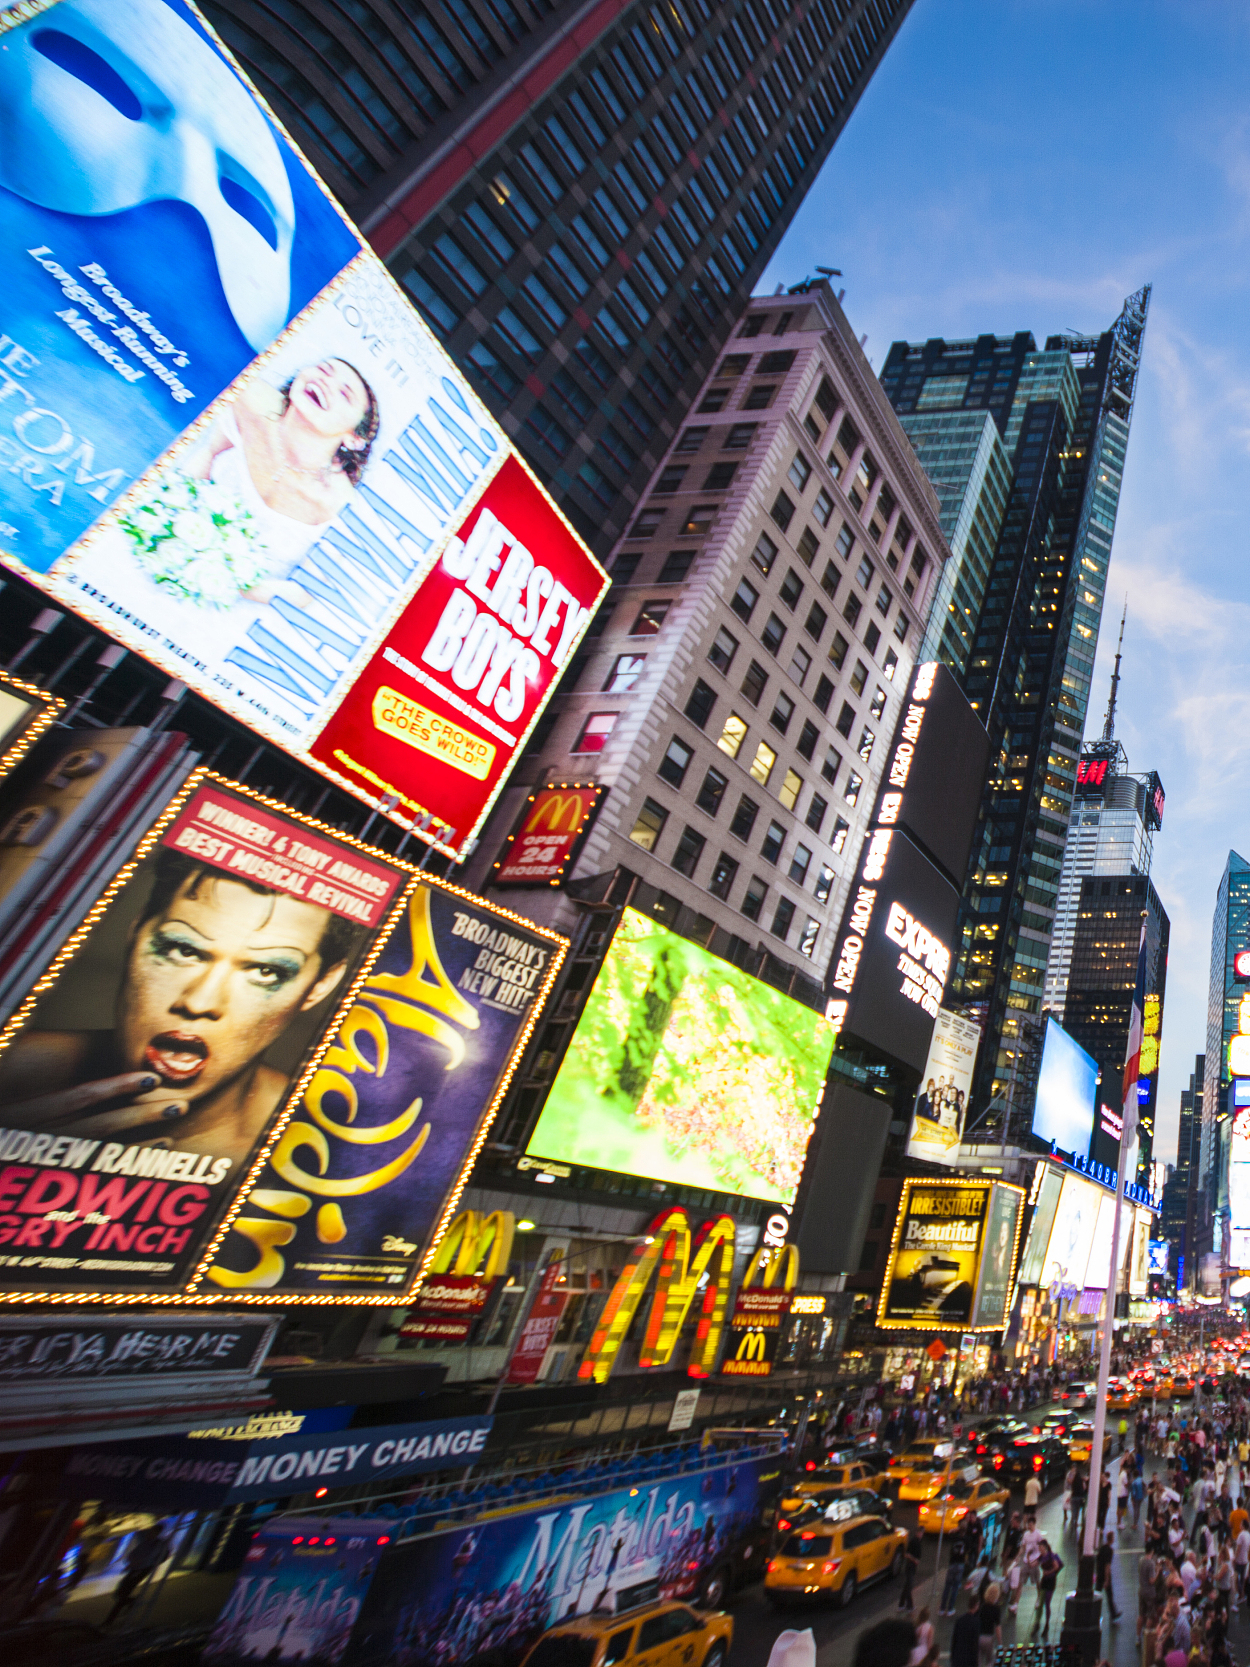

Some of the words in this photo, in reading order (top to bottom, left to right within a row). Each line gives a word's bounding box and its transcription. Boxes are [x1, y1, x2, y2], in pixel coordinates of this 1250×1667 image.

[26, 245, 195, 404] Longest-Running
[78, 261, 191, 369] Broadway's
[54, 307, 146, 383] Musical
[333, 293, 387, 358] LOVE
[384, 358, 410, 388] IT!
[225, 484, 434, 721] MAMMA
[382, 375, 498, 528] MIA!
[442, 508, 590, 668] JERSEY
[421, 588, 541, 723] BOYS
[382, 708, 431, 741] GOES
[430, 719, 488, 756] CROWD
[902, 704, 926, 744] NOW
[889, 742, 915, 789] OPEN
[197, 801, 274, 846] WINNER!
[273, 837, 288, 852] 4
[290, 842, 334, 872] TONY
[330, 861, 391, 897] AWARDS
[518, 846, 558, 863] 24
[522, 835, 569, 846] OPEN
[175, 827, 228, 863] BEST
[228, 847, 310, 895] MUSICAL
[307, 881, 374, 922] REVIVAL
[501, 865, 560, 876] HOURS
[849, 886, 877, 937] NOW
[457, 967, 500, 997] NEW
[474, 949, 540, 989] BIGGEST
[833, 935, 863, 993] OPEN
[90, 1143, 232, 1185] RANNELLS
[43, 1210, 81, 1222] and
[82, 1211, 112, 1225] the
[909, 1197, 985, 1216] IRRESISTIBLE!
[84, 1222, 193, 1255] INCH
[904, 1241, 915, 1250] The
[951, 1242, 976, 1252] Musical
[906, 1220, 980, 1242] Beautiful
[418, 1285, 487, 1300] McDonald's
[737, 1292, 790, 1305] McDonald's
[107, 1330, 194, 1361] HEAR
[187, 1332, 241, 1358] ME
[234, 1441, 372, 1488] MONEY
[369, 1428, 492, 1468] CHANGE
[516, 1485, 697, 1600] Matilda
